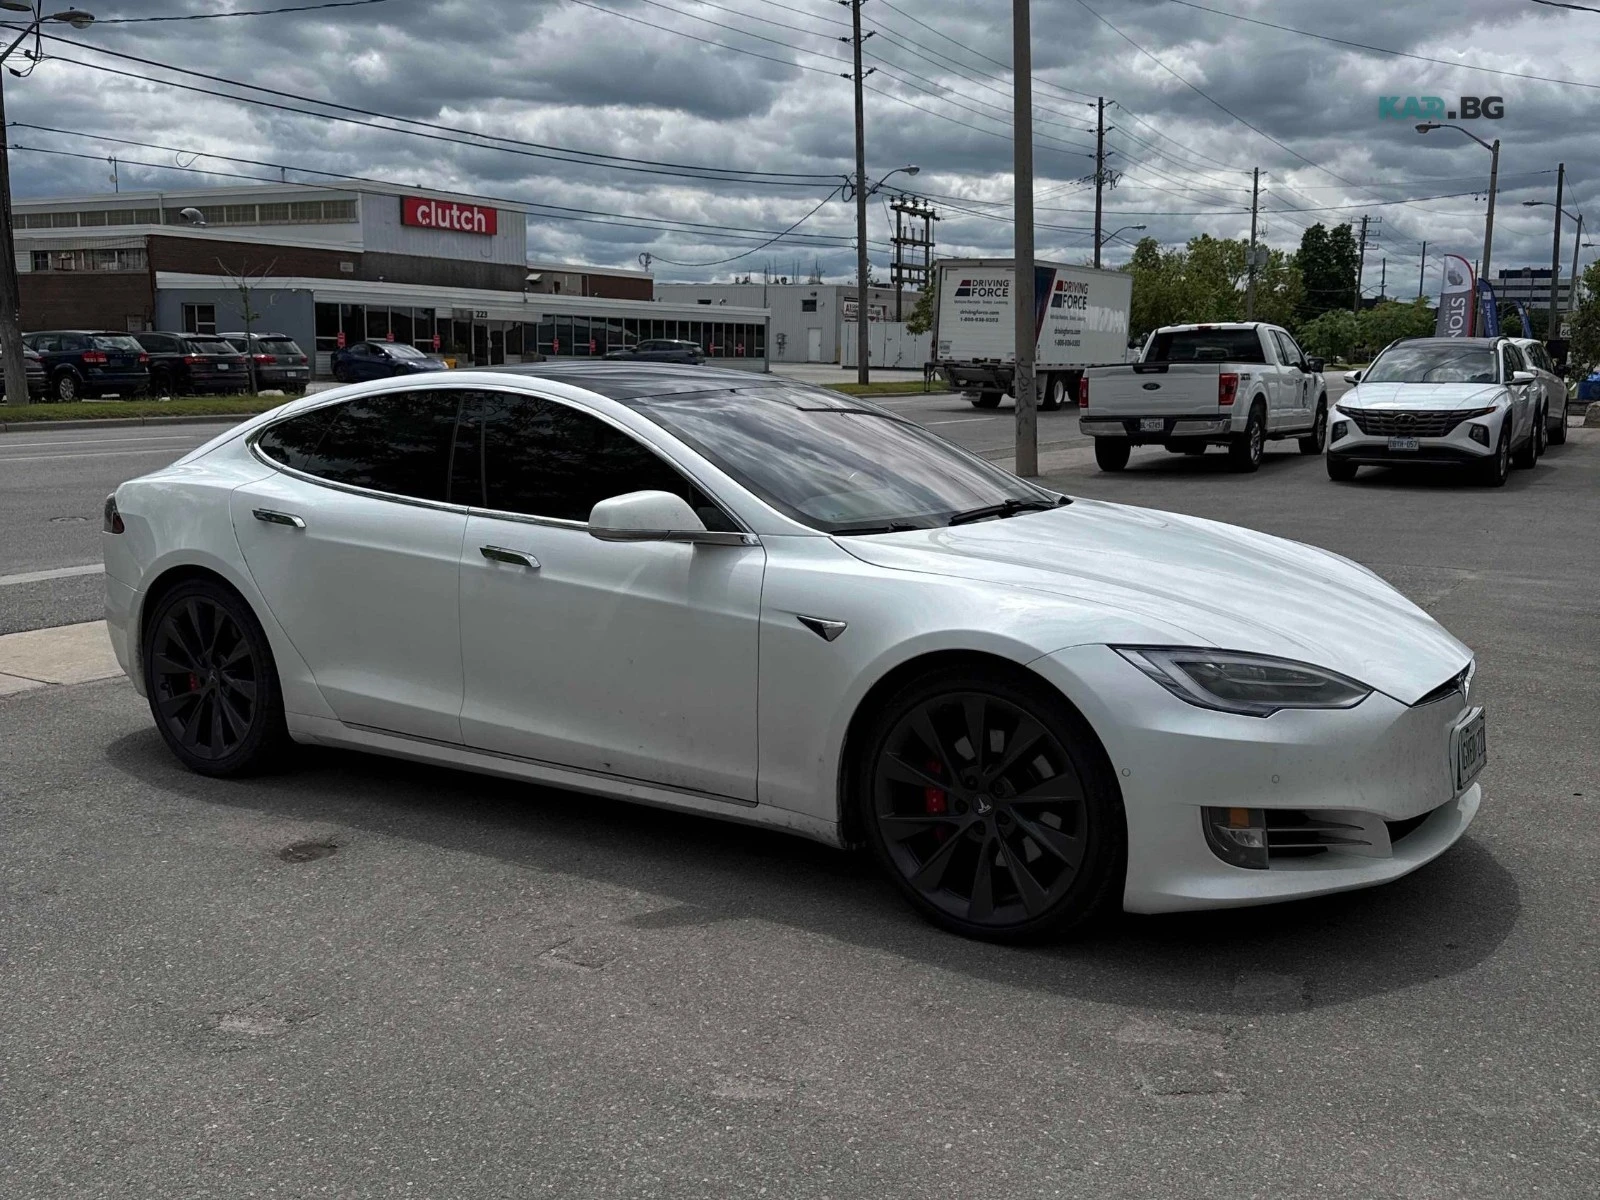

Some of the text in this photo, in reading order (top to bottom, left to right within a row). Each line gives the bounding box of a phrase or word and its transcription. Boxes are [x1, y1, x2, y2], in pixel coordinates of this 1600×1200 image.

[416, 201, 486, 232] clutch
[972, 279, 1010, 287] DRIVING
[1063, 281, 1089, 295] DRIVING
[971, 287, 1009, 297] FORCE
[1063, 294, 1087, 310] FORCE
